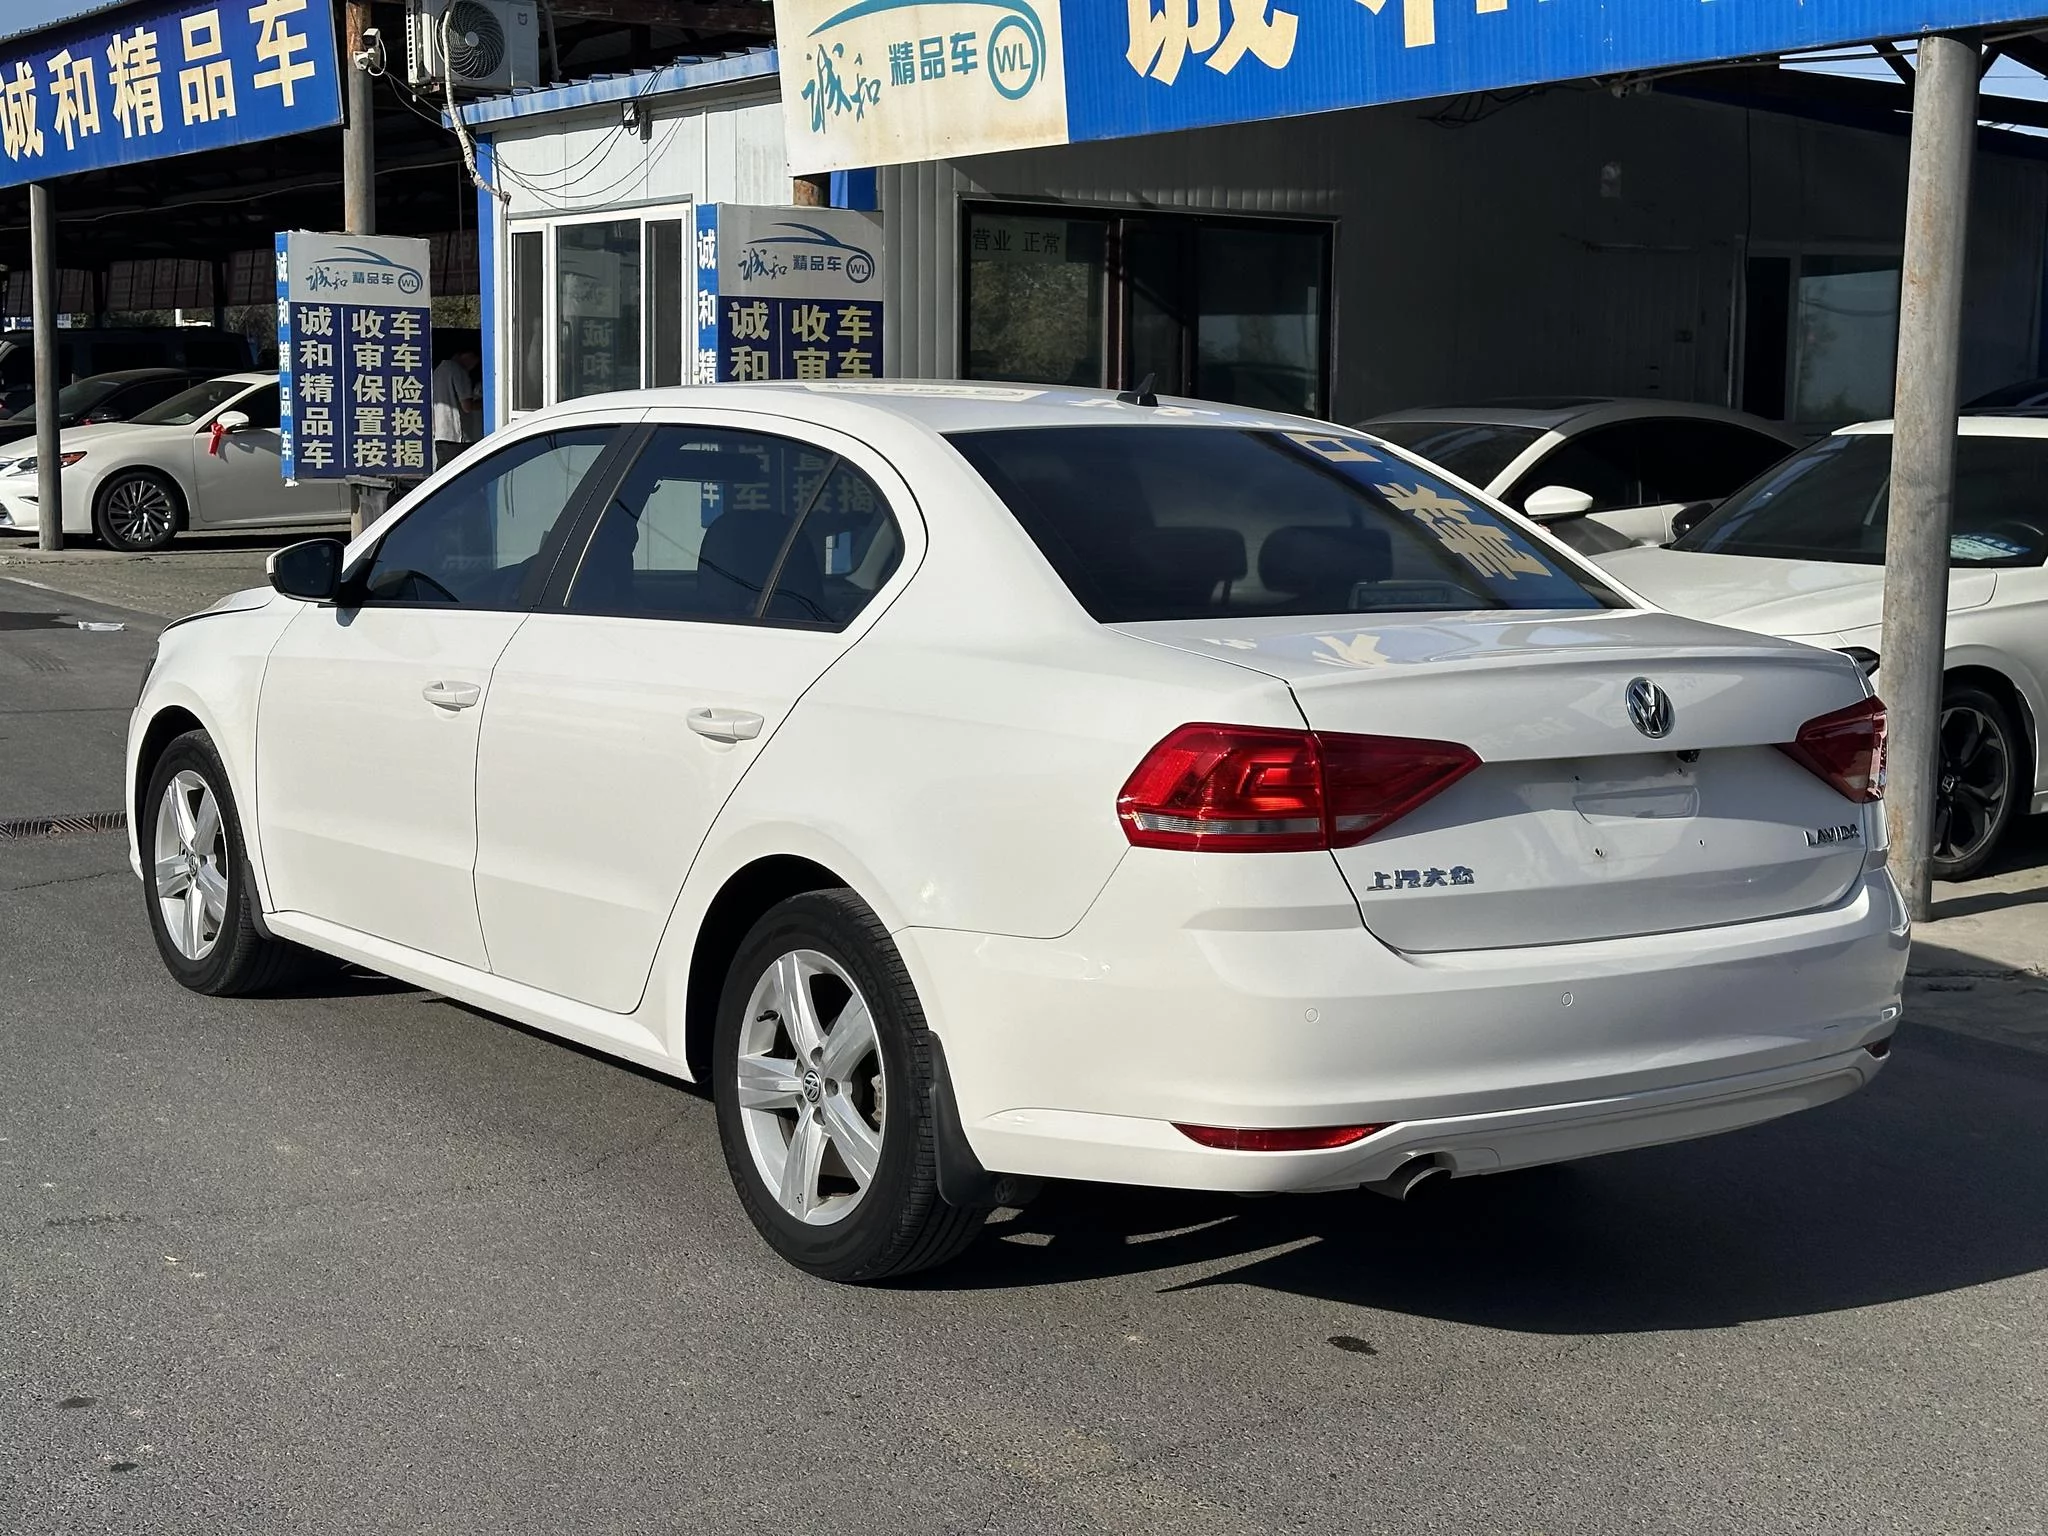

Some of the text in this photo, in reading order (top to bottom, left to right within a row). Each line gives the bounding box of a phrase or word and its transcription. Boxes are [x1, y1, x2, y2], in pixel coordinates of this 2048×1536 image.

[888, 32, 978, 86] 精品车
[994, 43, 1031, 74] WL
[0, 0, 316, 162] 诚和精品车
[973, 228, 1060, 255] 营业 正常
[352, 271, 395, 285] 精品车
[793, 254, 842, 272] 精品车
[351, 309, 422, 340] 收车
[792, 304, 873, 344] 收车
[276, 252, 292, 460] 诚和精品车
[352, 341, 423, 373] 审车
[297, 305, 334, 469] 诚和精品车
[352, 373, 424, 404] 保险
[353, 407, 425, 437] 置换
[352, 438, 425, 469] 按揭
[1803, 824, 1860, 846] LAVIDA
